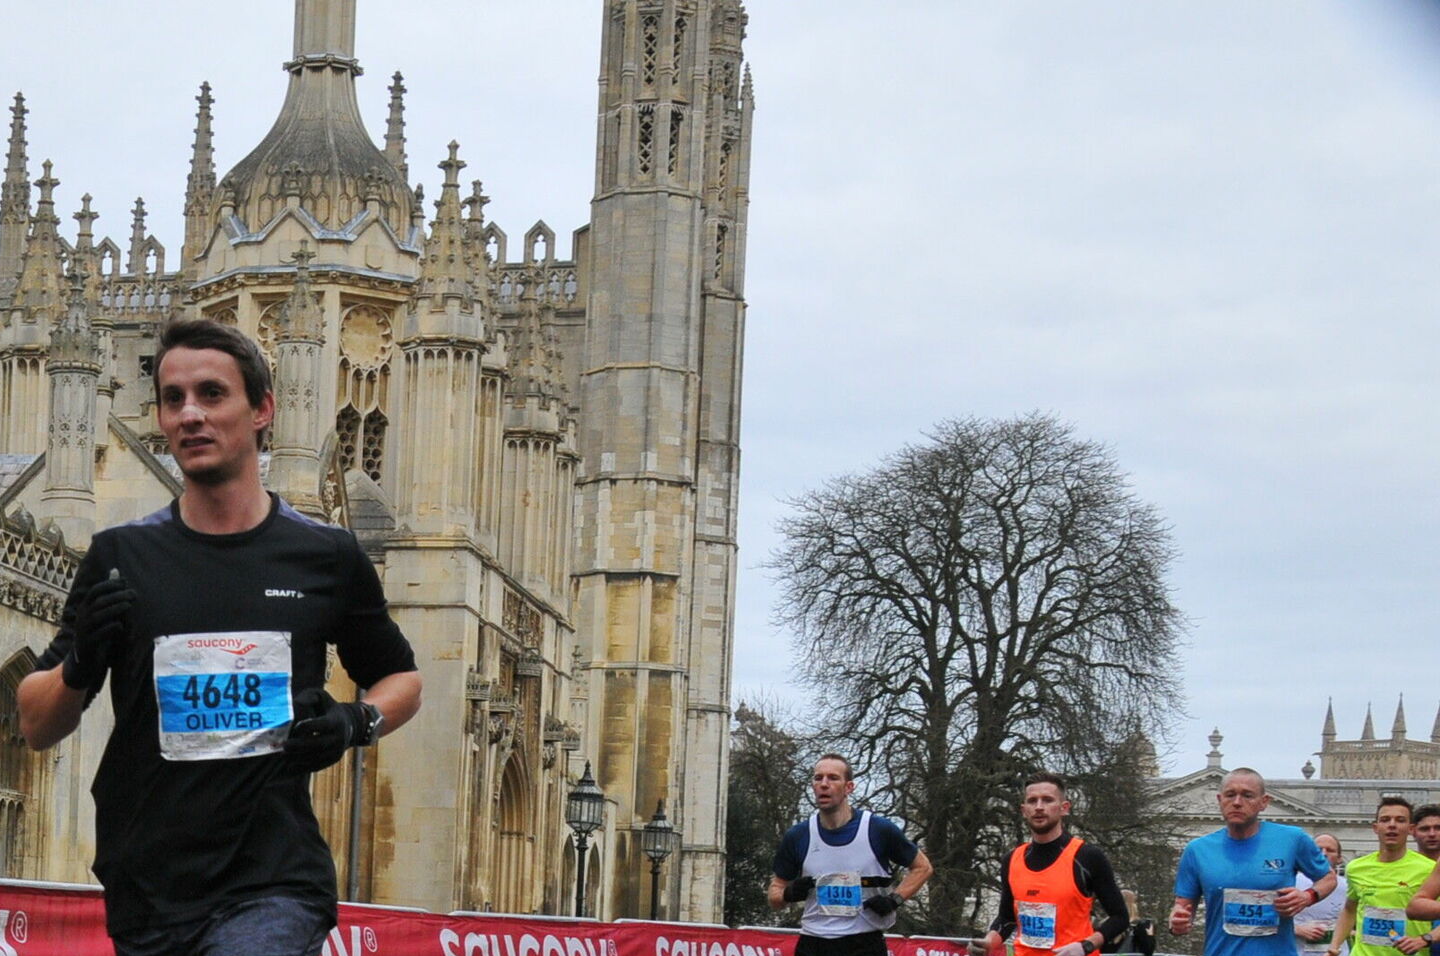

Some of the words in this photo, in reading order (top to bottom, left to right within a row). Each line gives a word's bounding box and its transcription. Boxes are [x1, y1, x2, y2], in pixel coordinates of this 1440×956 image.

[264, 588, 297, 598] CRAFT
[186, 637, 244, 650] saucony
[182, 673, 263, 709] 4648
[185, 712, 263, 730] OLIVER
[827, 885, 852, 899] 1316
[1238, 904, 1264, 918] 454
[1368, 918, 1396, 931] 2553
